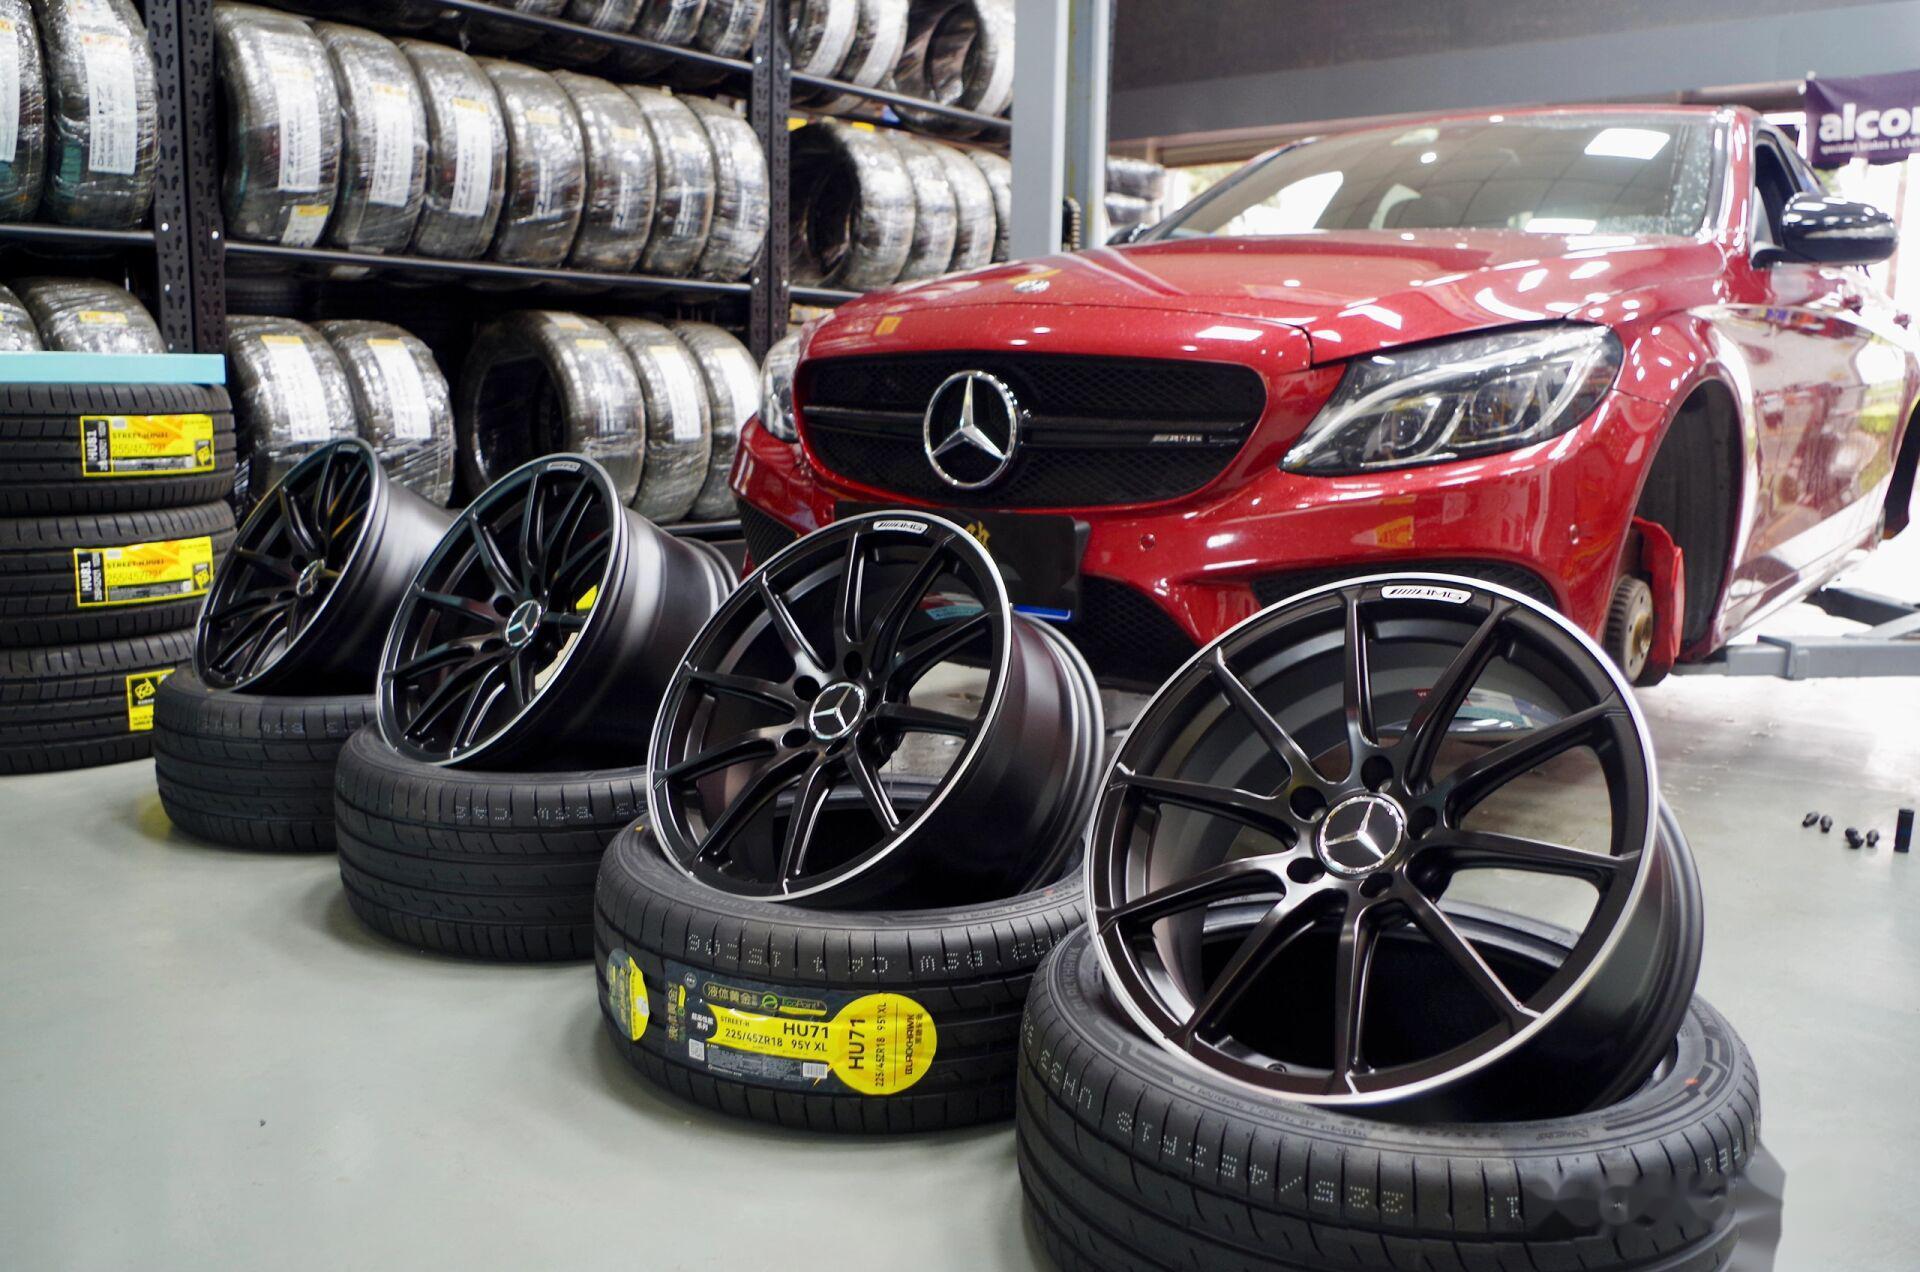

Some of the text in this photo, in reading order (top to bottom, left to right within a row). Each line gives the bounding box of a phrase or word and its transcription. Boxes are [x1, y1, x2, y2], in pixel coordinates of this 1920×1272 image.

[725, 1028, 783, 1047] 225/45ZR18
[791, 1039, 811, 1052] 95Y
[814, 1042, 828, 1053] XL
[783, 1022, 829, 1039] HU71
[848, 1019, 865, 1070] HU71
[875, 1036, 887, 1087] 225/45ZR18
